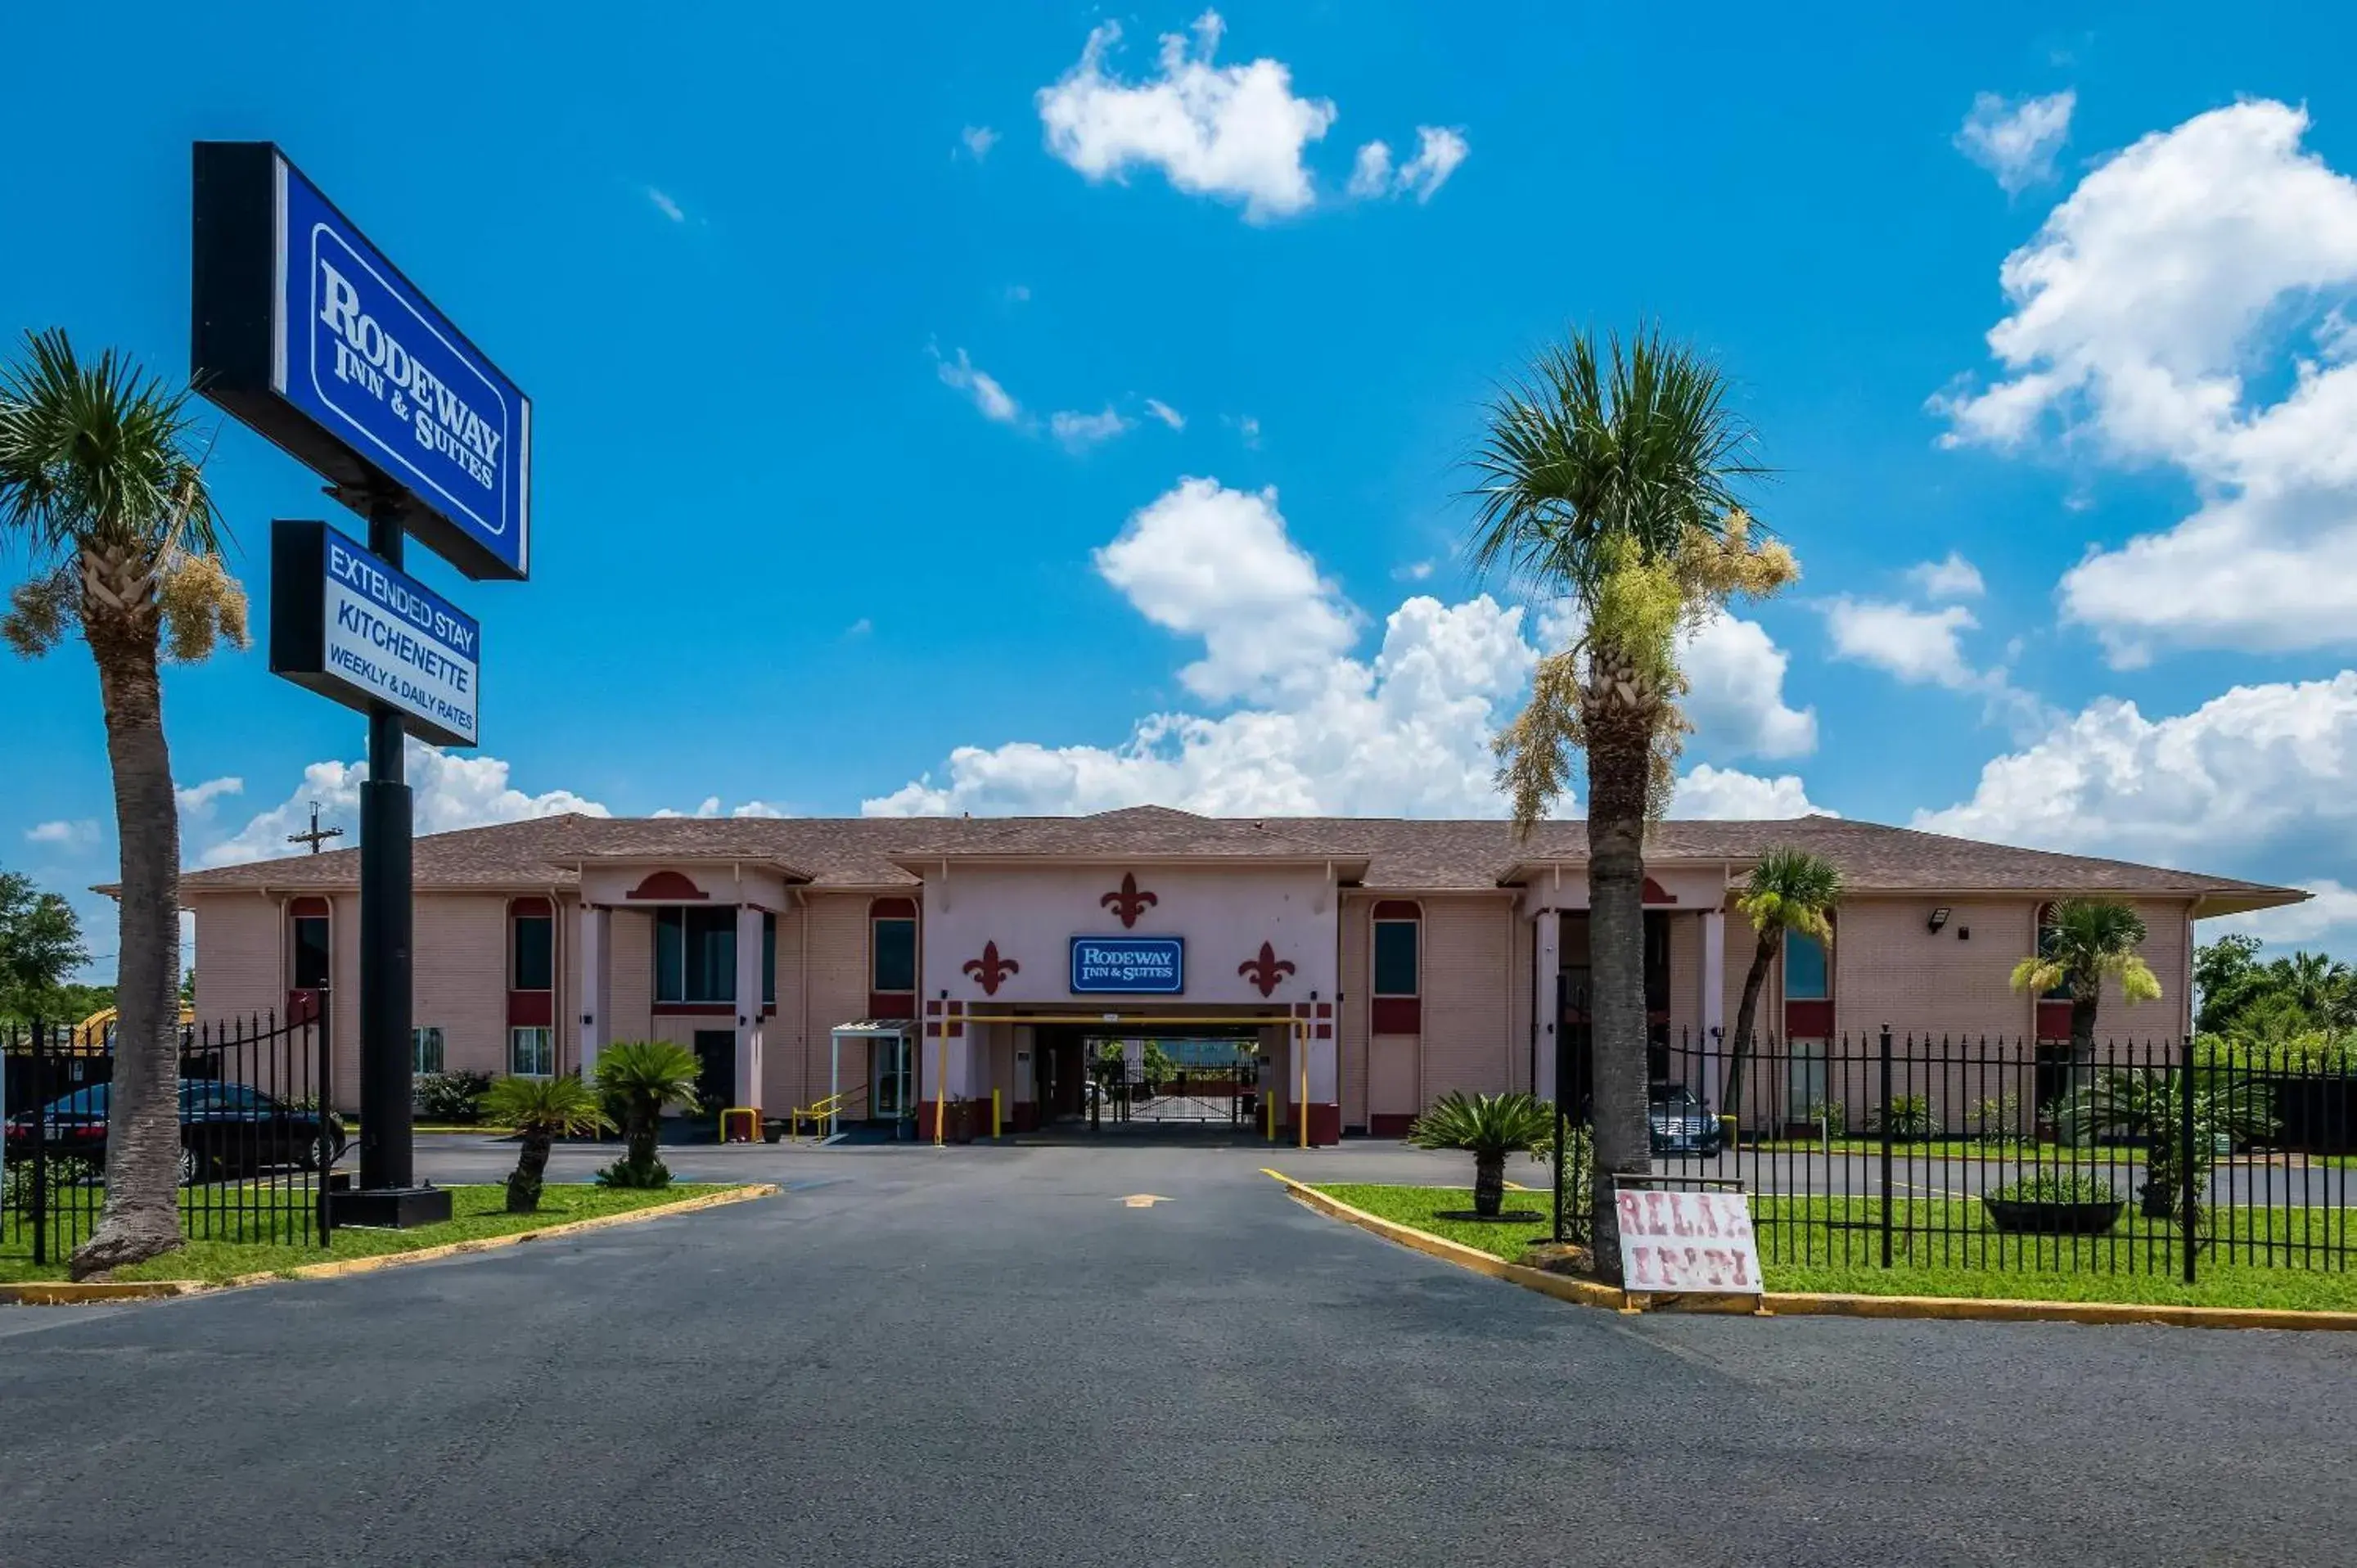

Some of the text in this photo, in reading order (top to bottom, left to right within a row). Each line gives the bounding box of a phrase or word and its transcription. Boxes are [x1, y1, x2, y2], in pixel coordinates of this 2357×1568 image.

[320, 259, 501, 468] RODEWAY
[336, 339, 493, 490] INN & SUITES
[331, 544, 475, 653] EXTENDED STAY
[331, 643, 473, 730] WEEKLY & DAILY RATES
[338, 599, 469, 693] KITCHENETTE
[1082, 966, 1174, 981] INN & SUITES
[1084, 948, 1172, 966] RODEWAY
